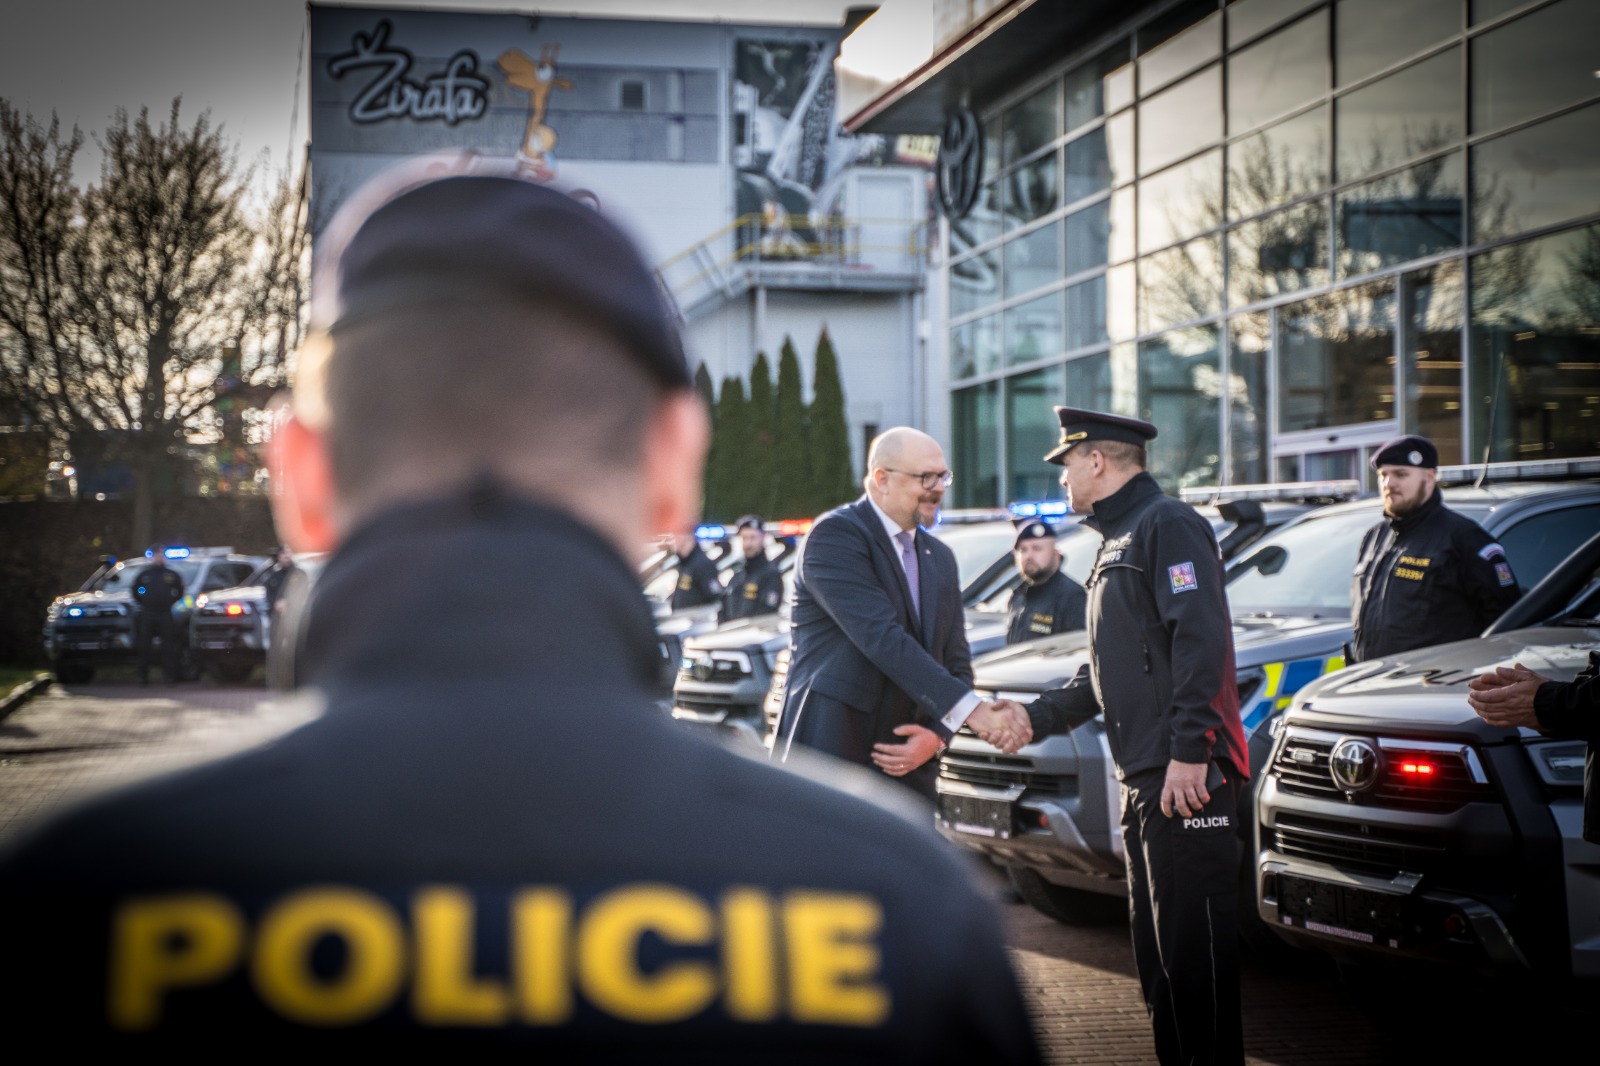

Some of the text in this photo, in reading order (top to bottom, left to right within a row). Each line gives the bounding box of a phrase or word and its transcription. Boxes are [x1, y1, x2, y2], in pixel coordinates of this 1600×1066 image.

[329, 19, 489, 125] Žirafa
[1183, 816, 1229, 829] POLICIE
[109, 886, 890, 1026] POLICIE
